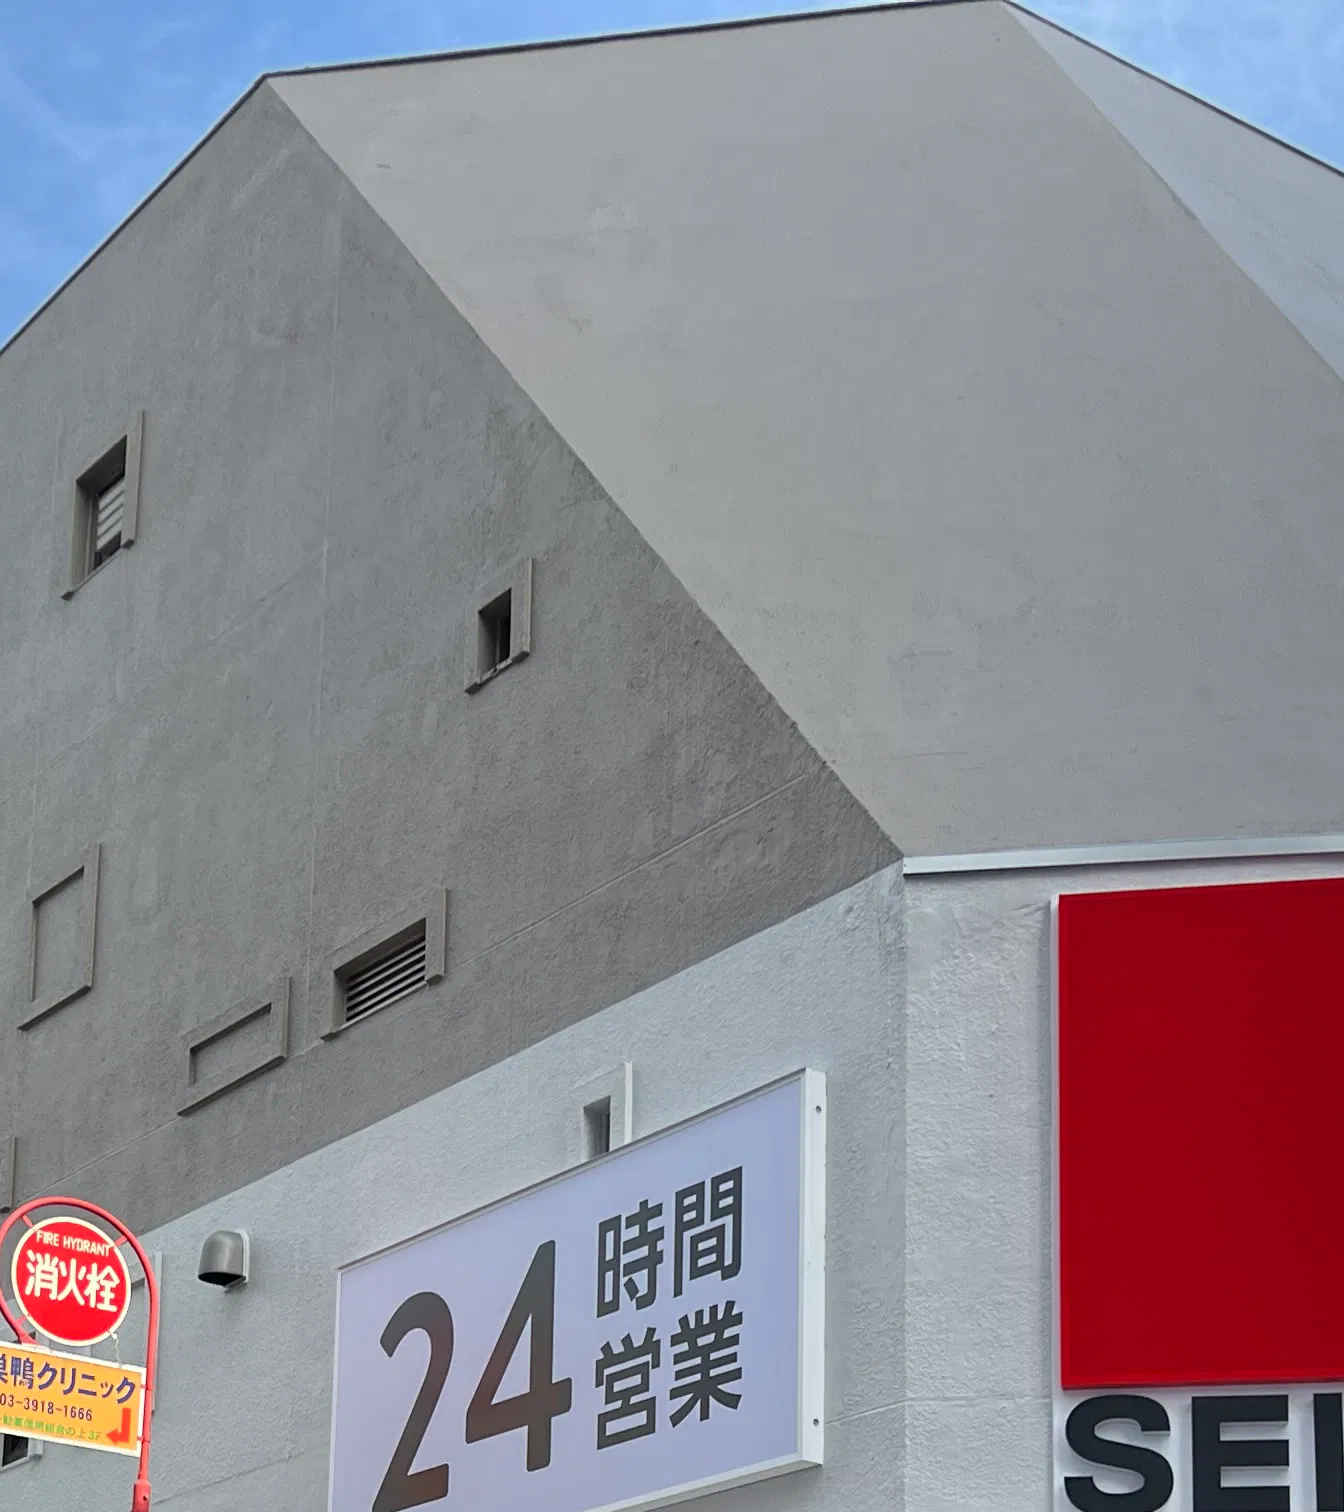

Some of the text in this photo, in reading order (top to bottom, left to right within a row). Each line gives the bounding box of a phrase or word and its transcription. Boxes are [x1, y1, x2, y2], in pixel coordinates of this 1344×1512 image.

[24, 1250, 120, 1312] 消火栓
[36, 1230, 111, 1257] FIRE HYDRANT
[595, 1165, 743, 1319] 時間
[594, 1299, 743, 1450] 営業
